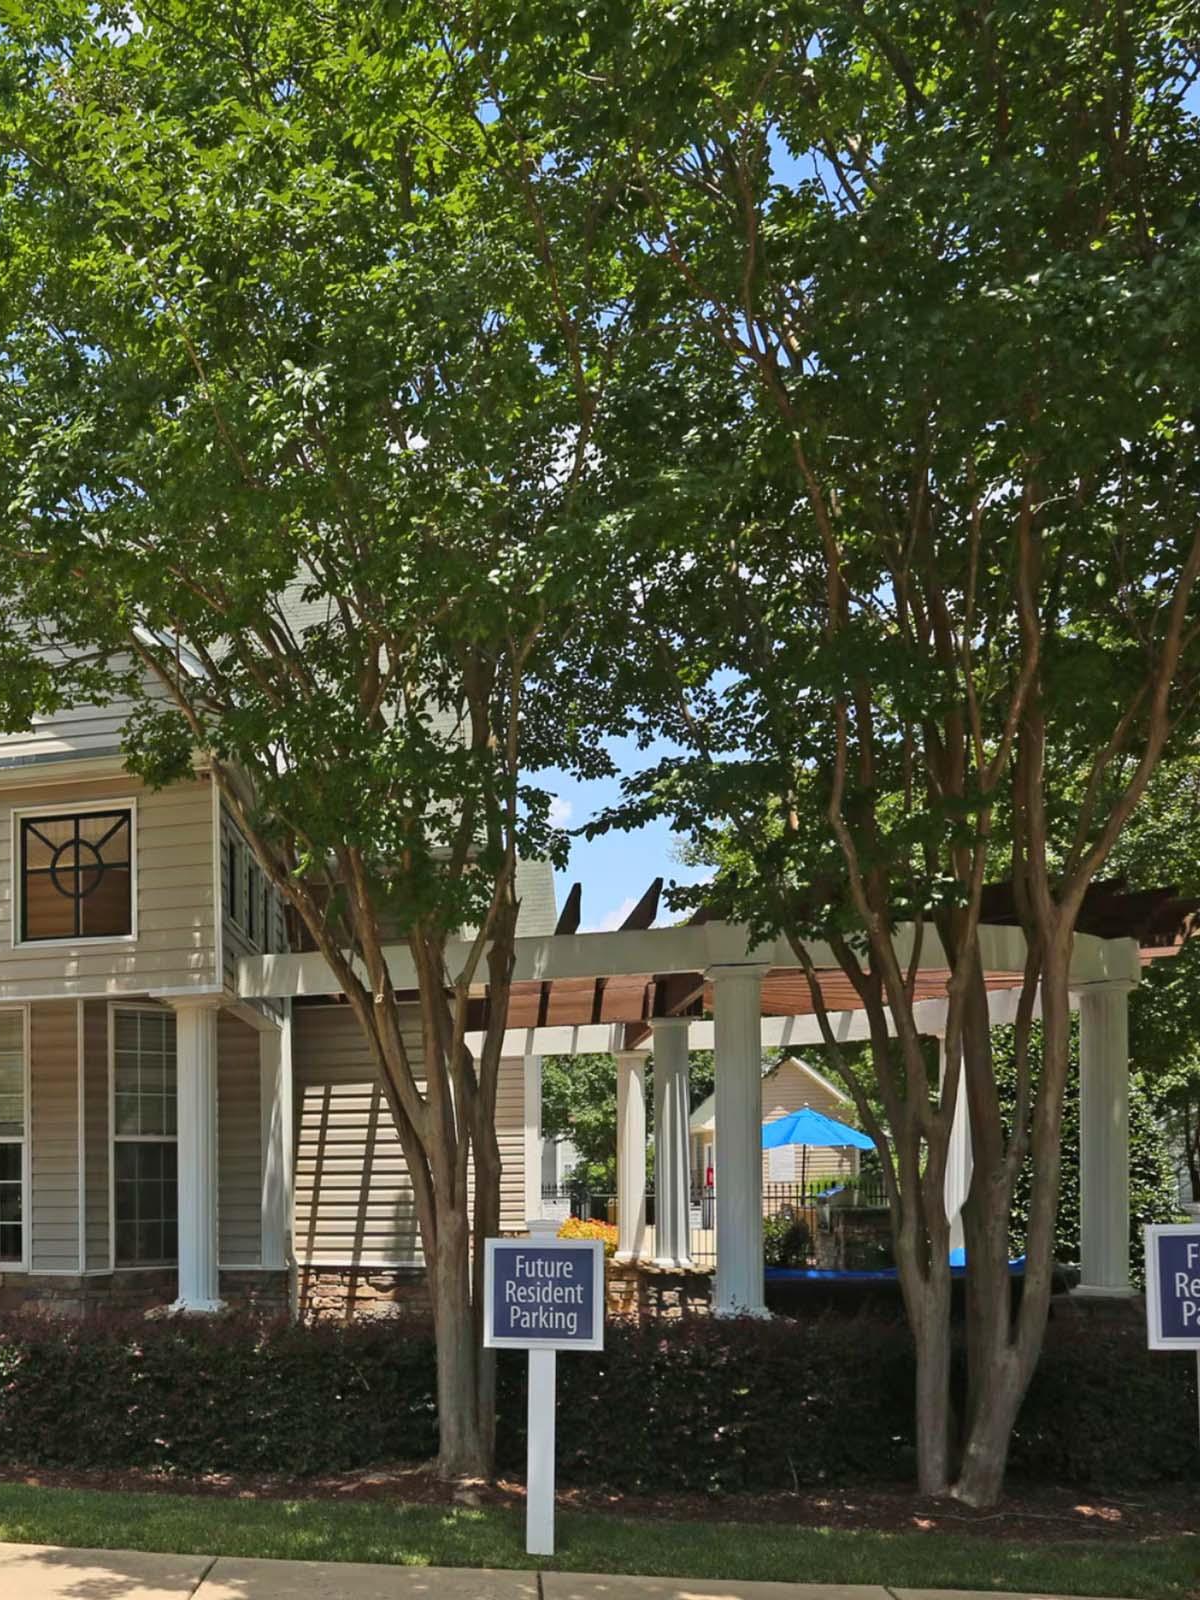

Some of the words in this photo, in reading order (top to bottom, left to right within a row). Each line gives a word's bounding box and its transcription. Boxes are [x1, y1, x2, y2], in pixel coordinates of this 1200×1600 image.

[515, 1255, 573, 1278] Future
[505, 1280, 584, 1304] Resident
[510, 1305, 577, 1335] Parking
